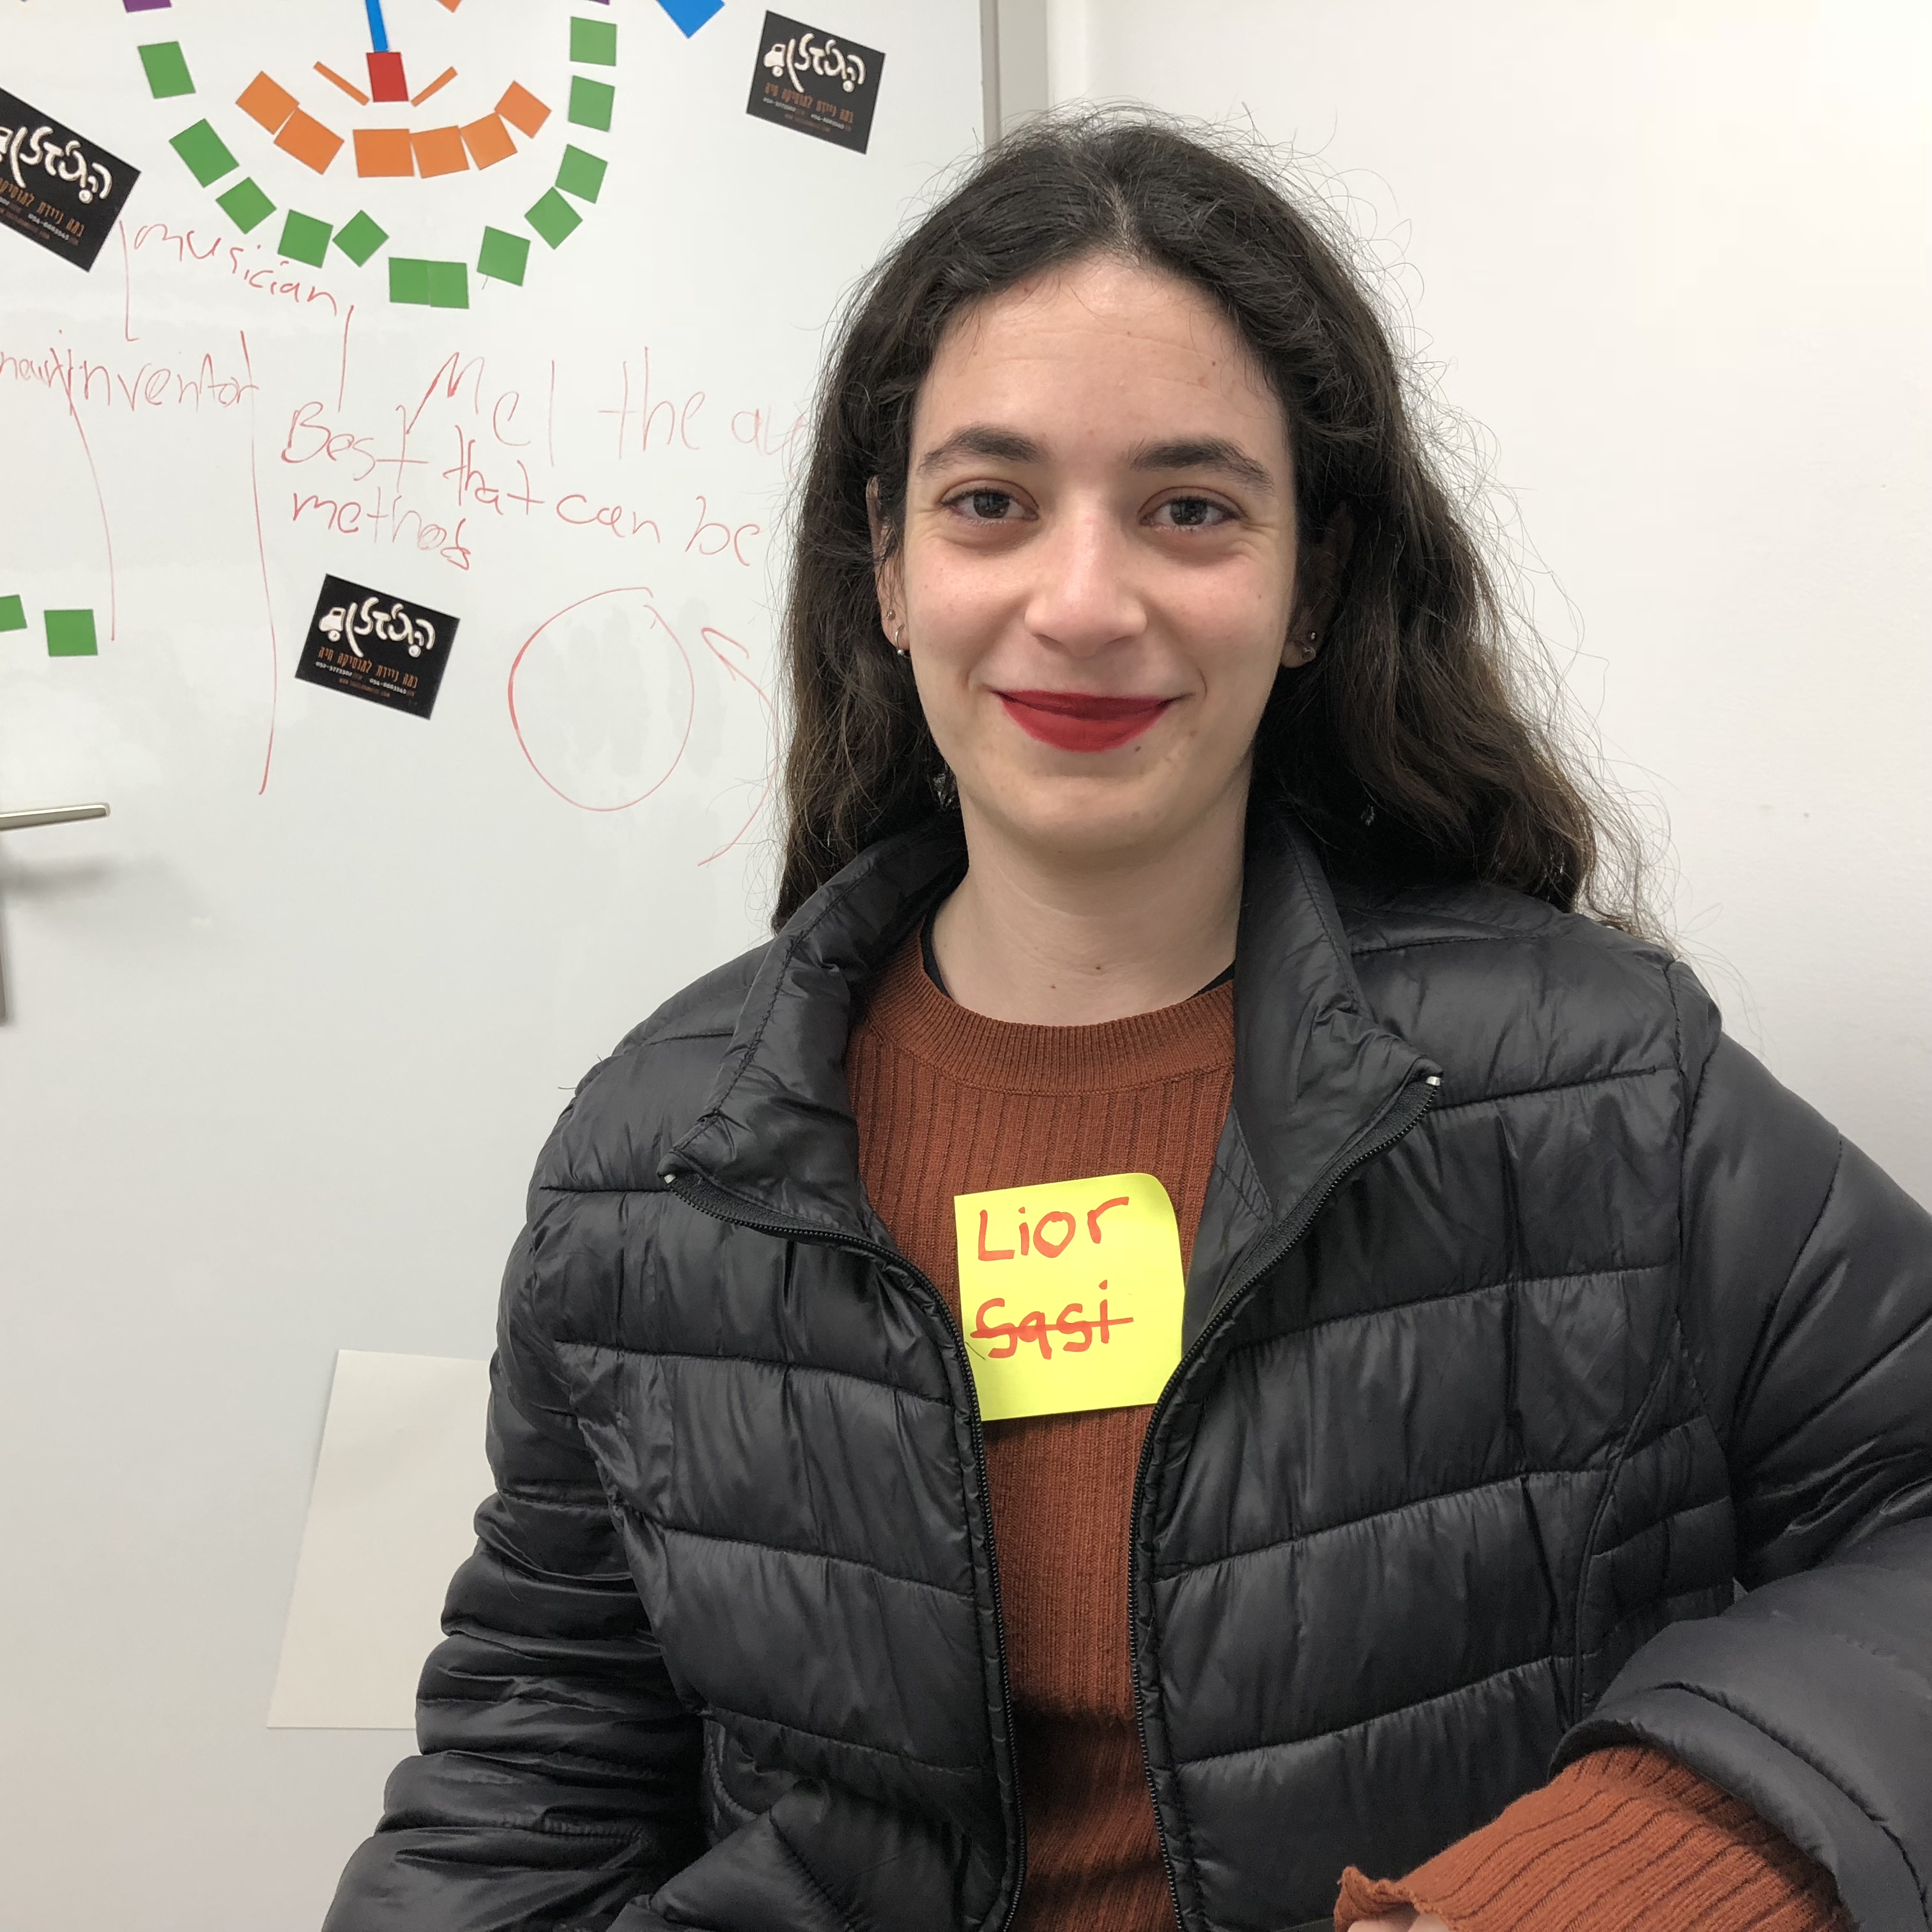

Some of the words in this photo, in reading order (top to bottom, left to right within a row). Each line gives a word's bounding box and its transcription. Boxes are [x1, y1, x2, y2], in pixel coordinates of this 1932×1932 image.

[134, 224, 337, 316] musician
[597, 346, 705, 459] the
[281, 401, 429, 493] Best
[442, 425, 544, 516] that
[556, 494, 661, 544] can
[685, 496, 760, 567] be
[977, 1196, 1130, 1262] Lior
